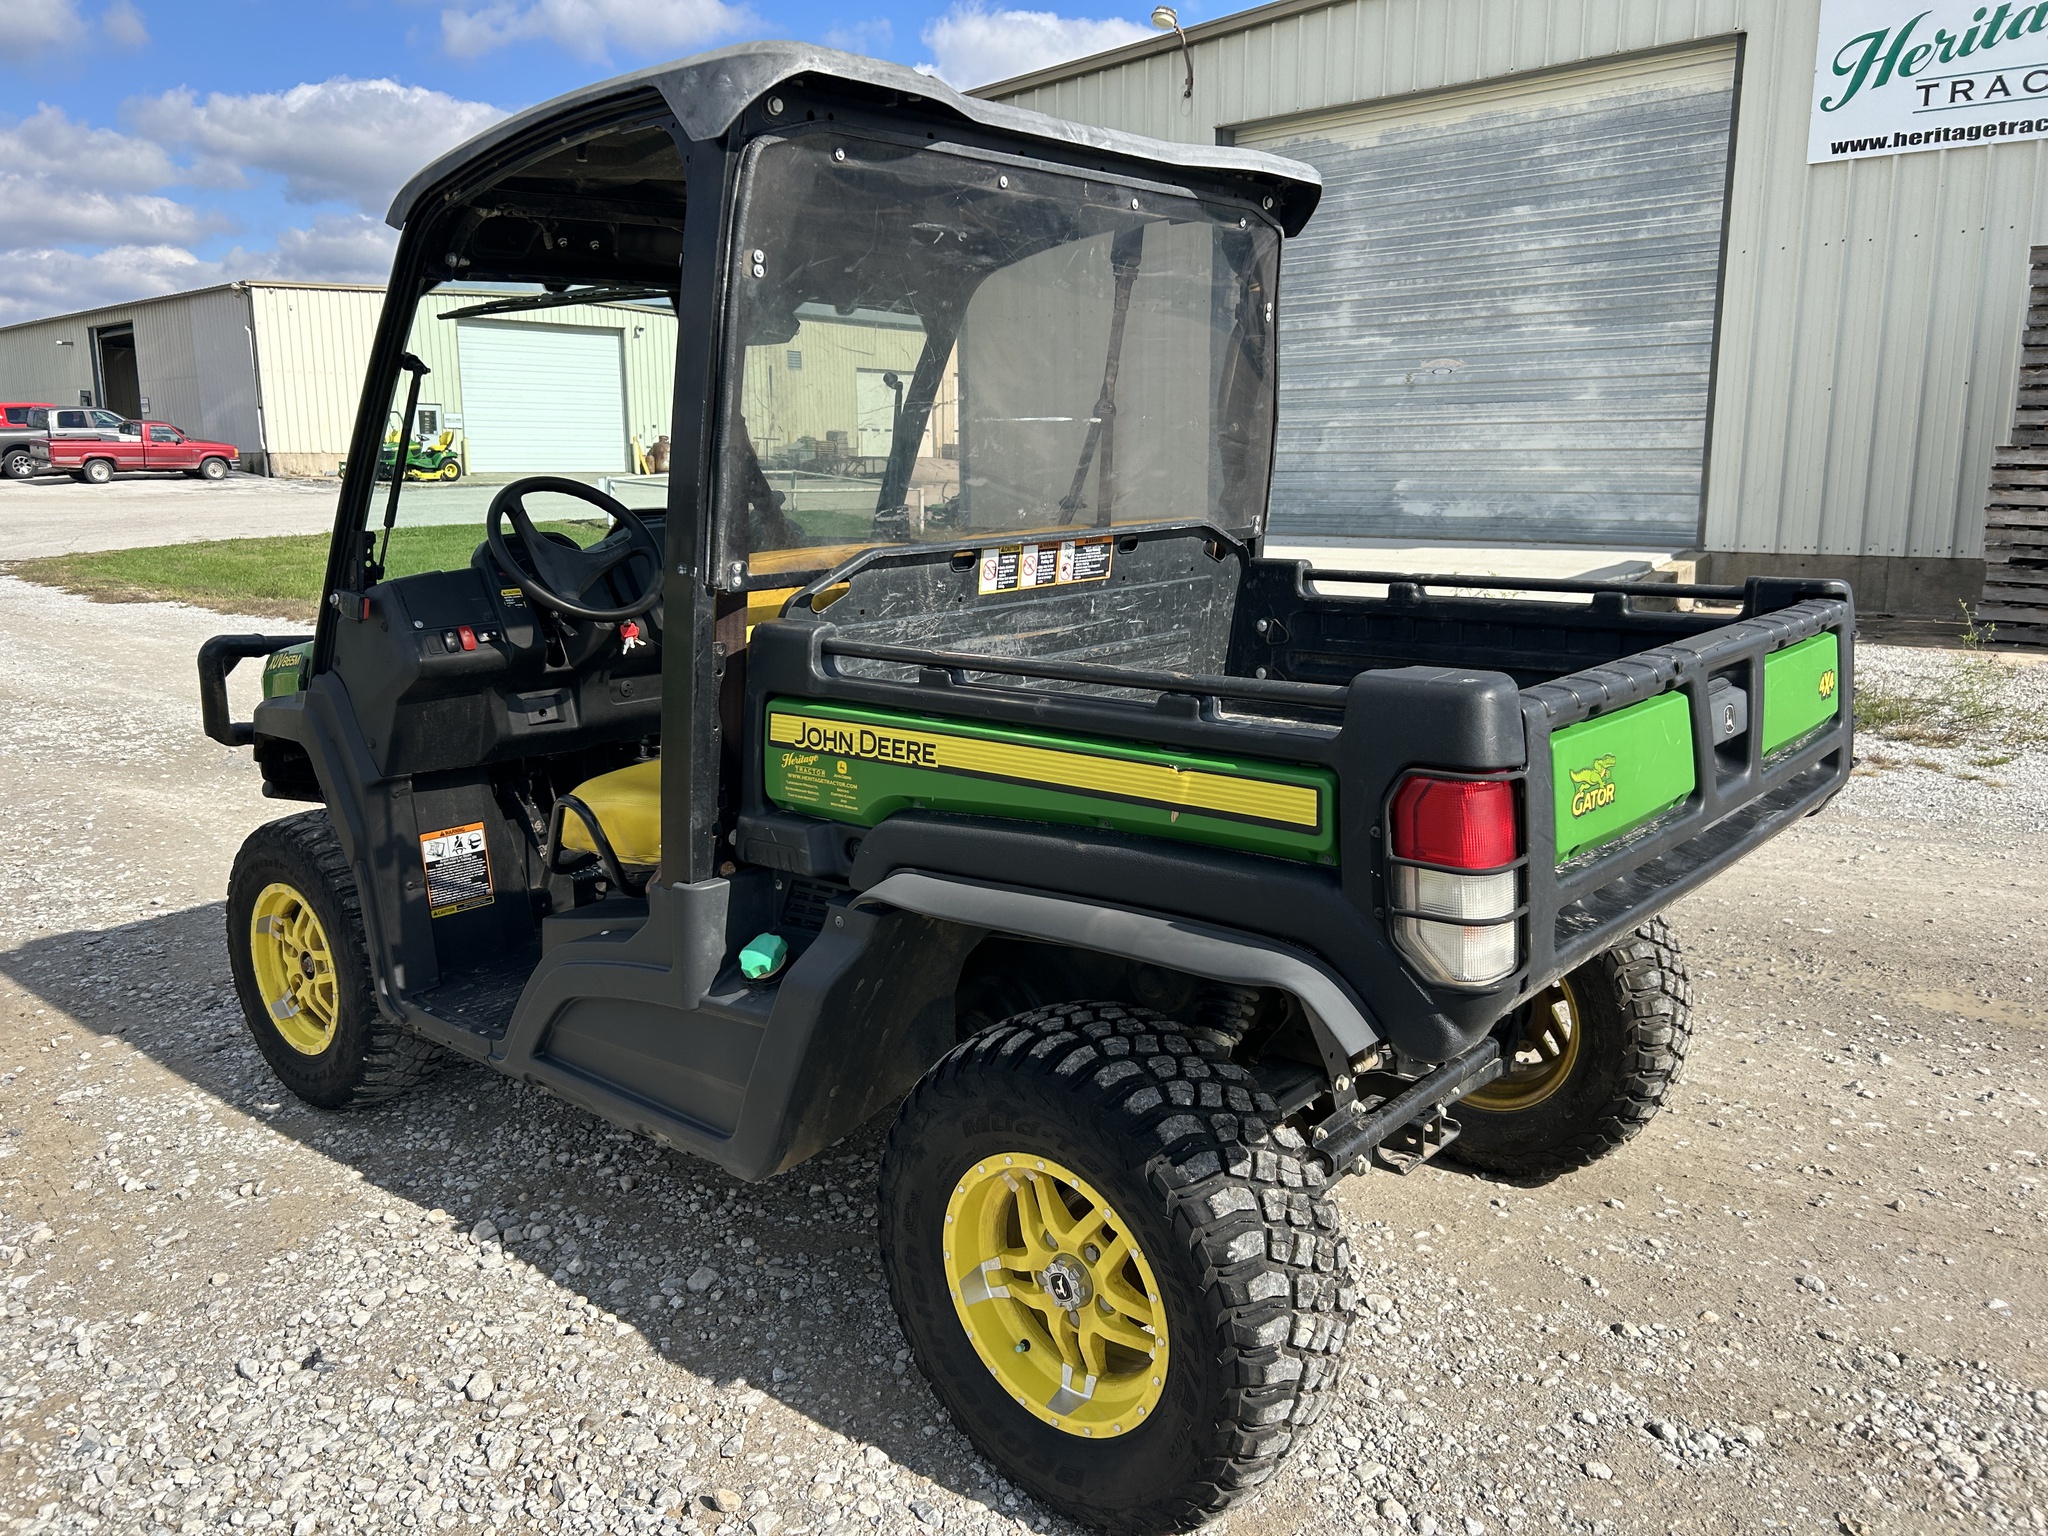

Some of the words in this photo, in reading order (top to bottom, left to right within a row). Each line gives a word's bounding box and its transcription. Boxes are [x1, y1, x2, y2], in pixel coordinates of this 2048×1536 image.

[1916, 69, 2048, 107] TRAC
[1830, 117, 2048, 155] www.heritagetrac
[1818, 669, 1835, 700] 4X4
[794, 721, 854, 754] JOHN
[859, 730, 938, 766] DEERE
[781, 752, 819, 768] Heritage
[795, 766, 826, 776] TRACTOR
[1572, 784, 1615, 818] GATOR
[445, 827, 465, 836] WARNING
[437, 906, 456, 915] CAUTION
